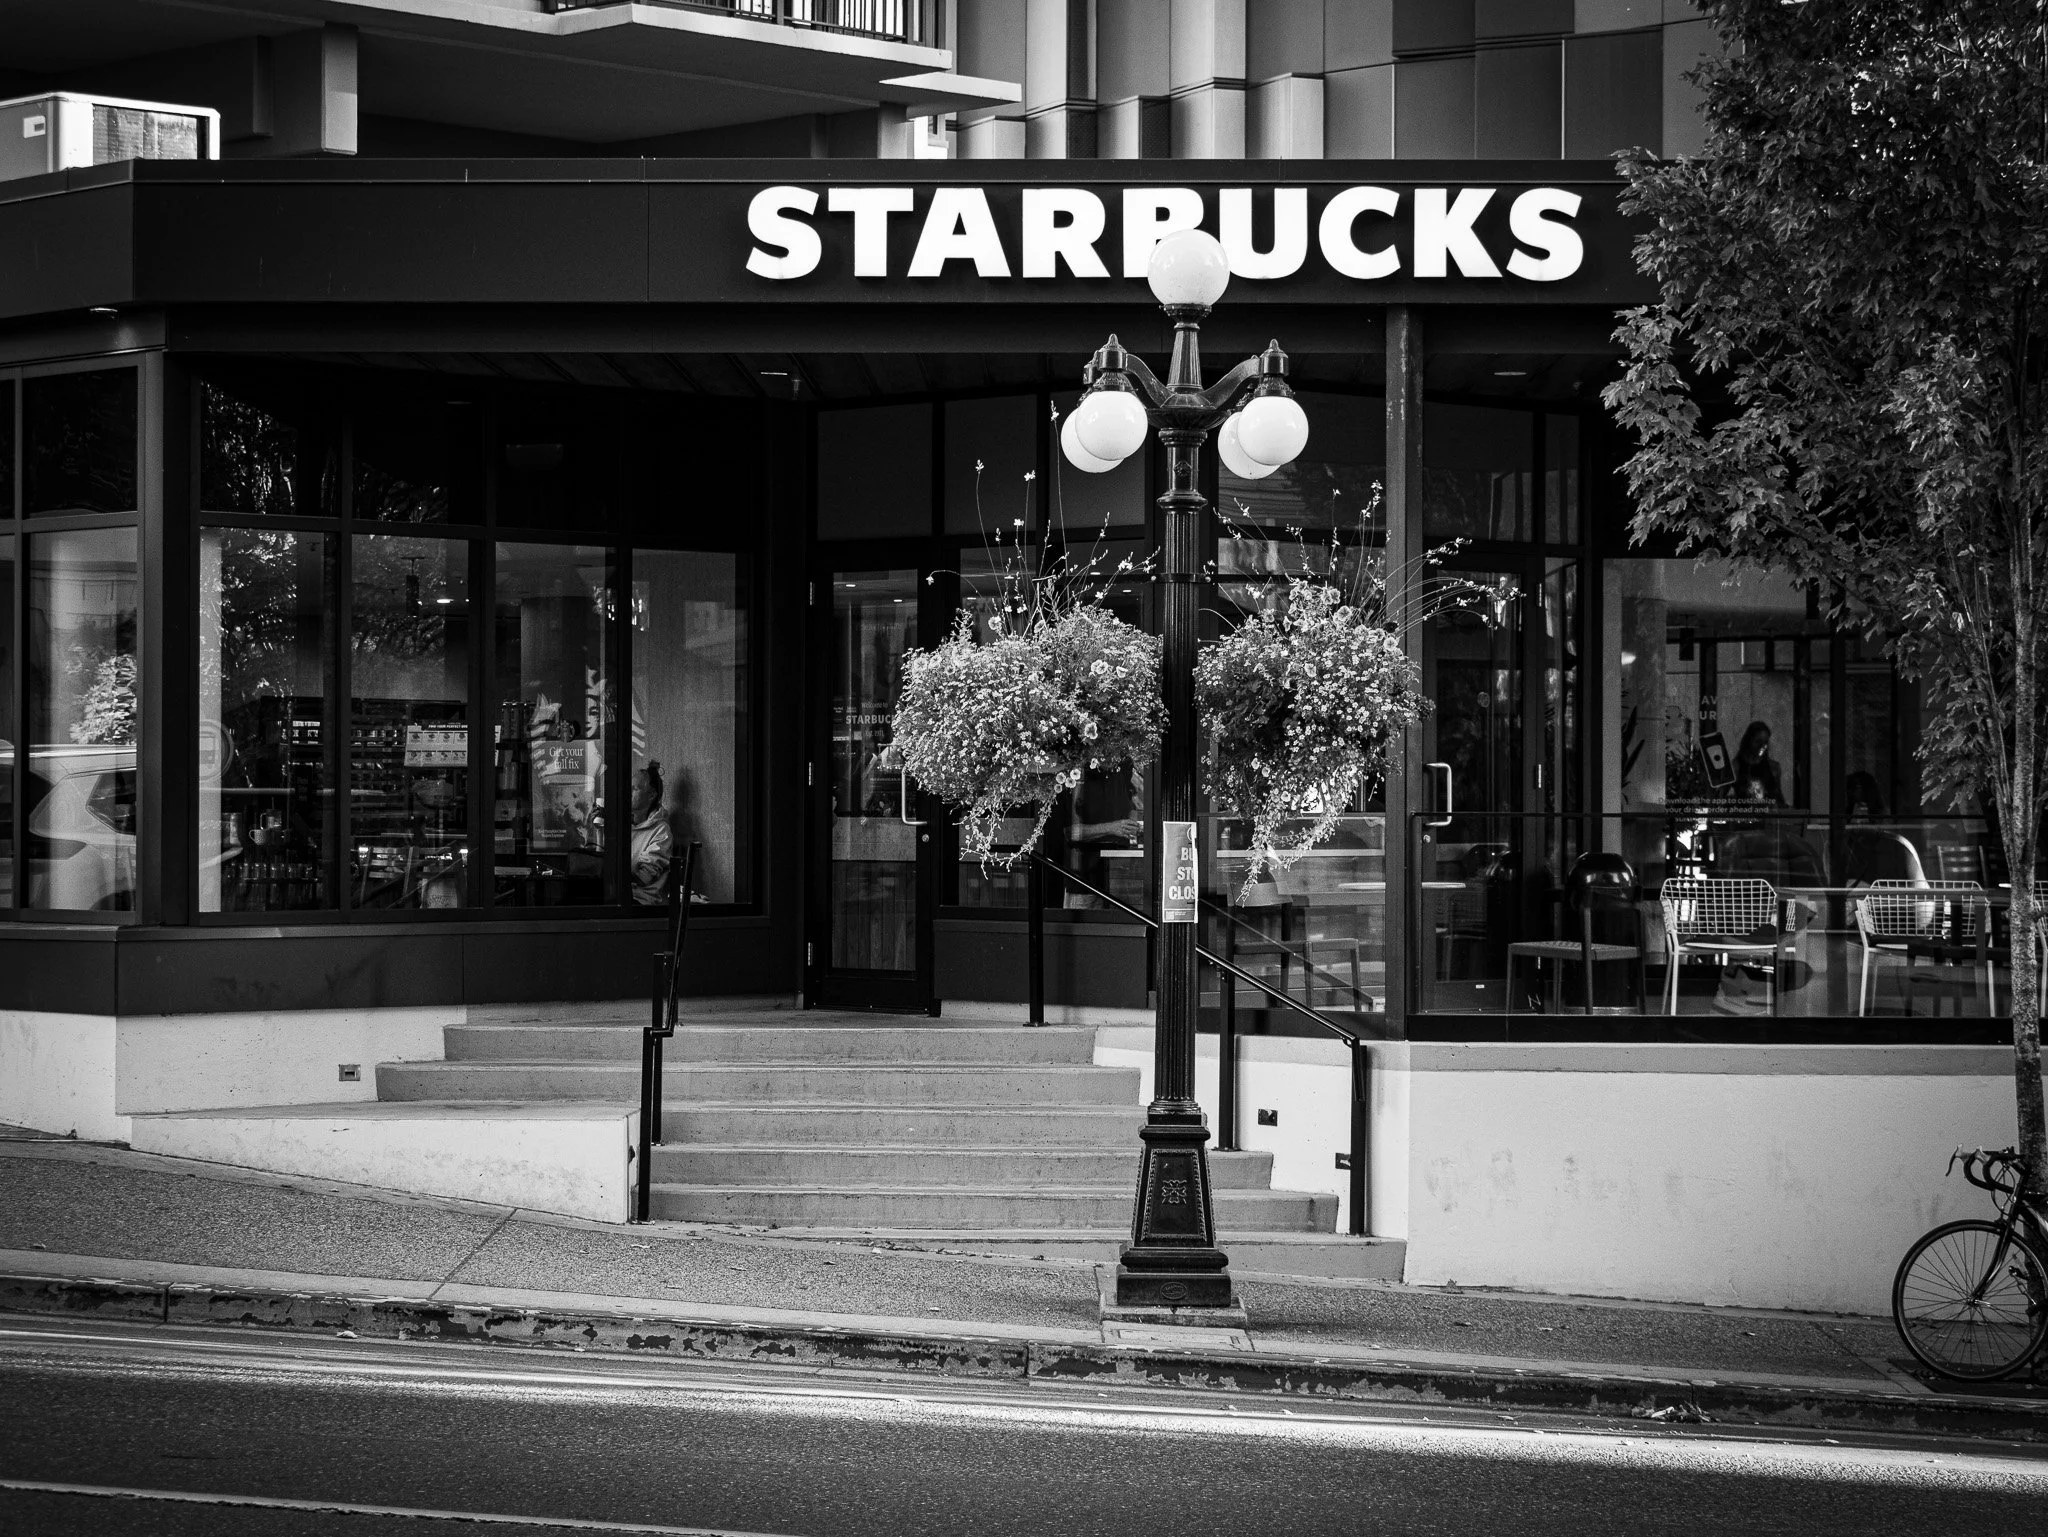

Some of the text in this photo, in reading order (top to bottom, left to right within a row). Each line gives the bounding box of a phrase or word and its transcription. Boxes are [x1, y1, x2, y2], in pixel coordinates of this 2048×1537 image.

[745, 185, 1585, 282] STARBUCKS
[549, 746, 584, 759] Get your
[553, 758, 580, 769] fall fix
[1665, 807, 1682, 815] your
